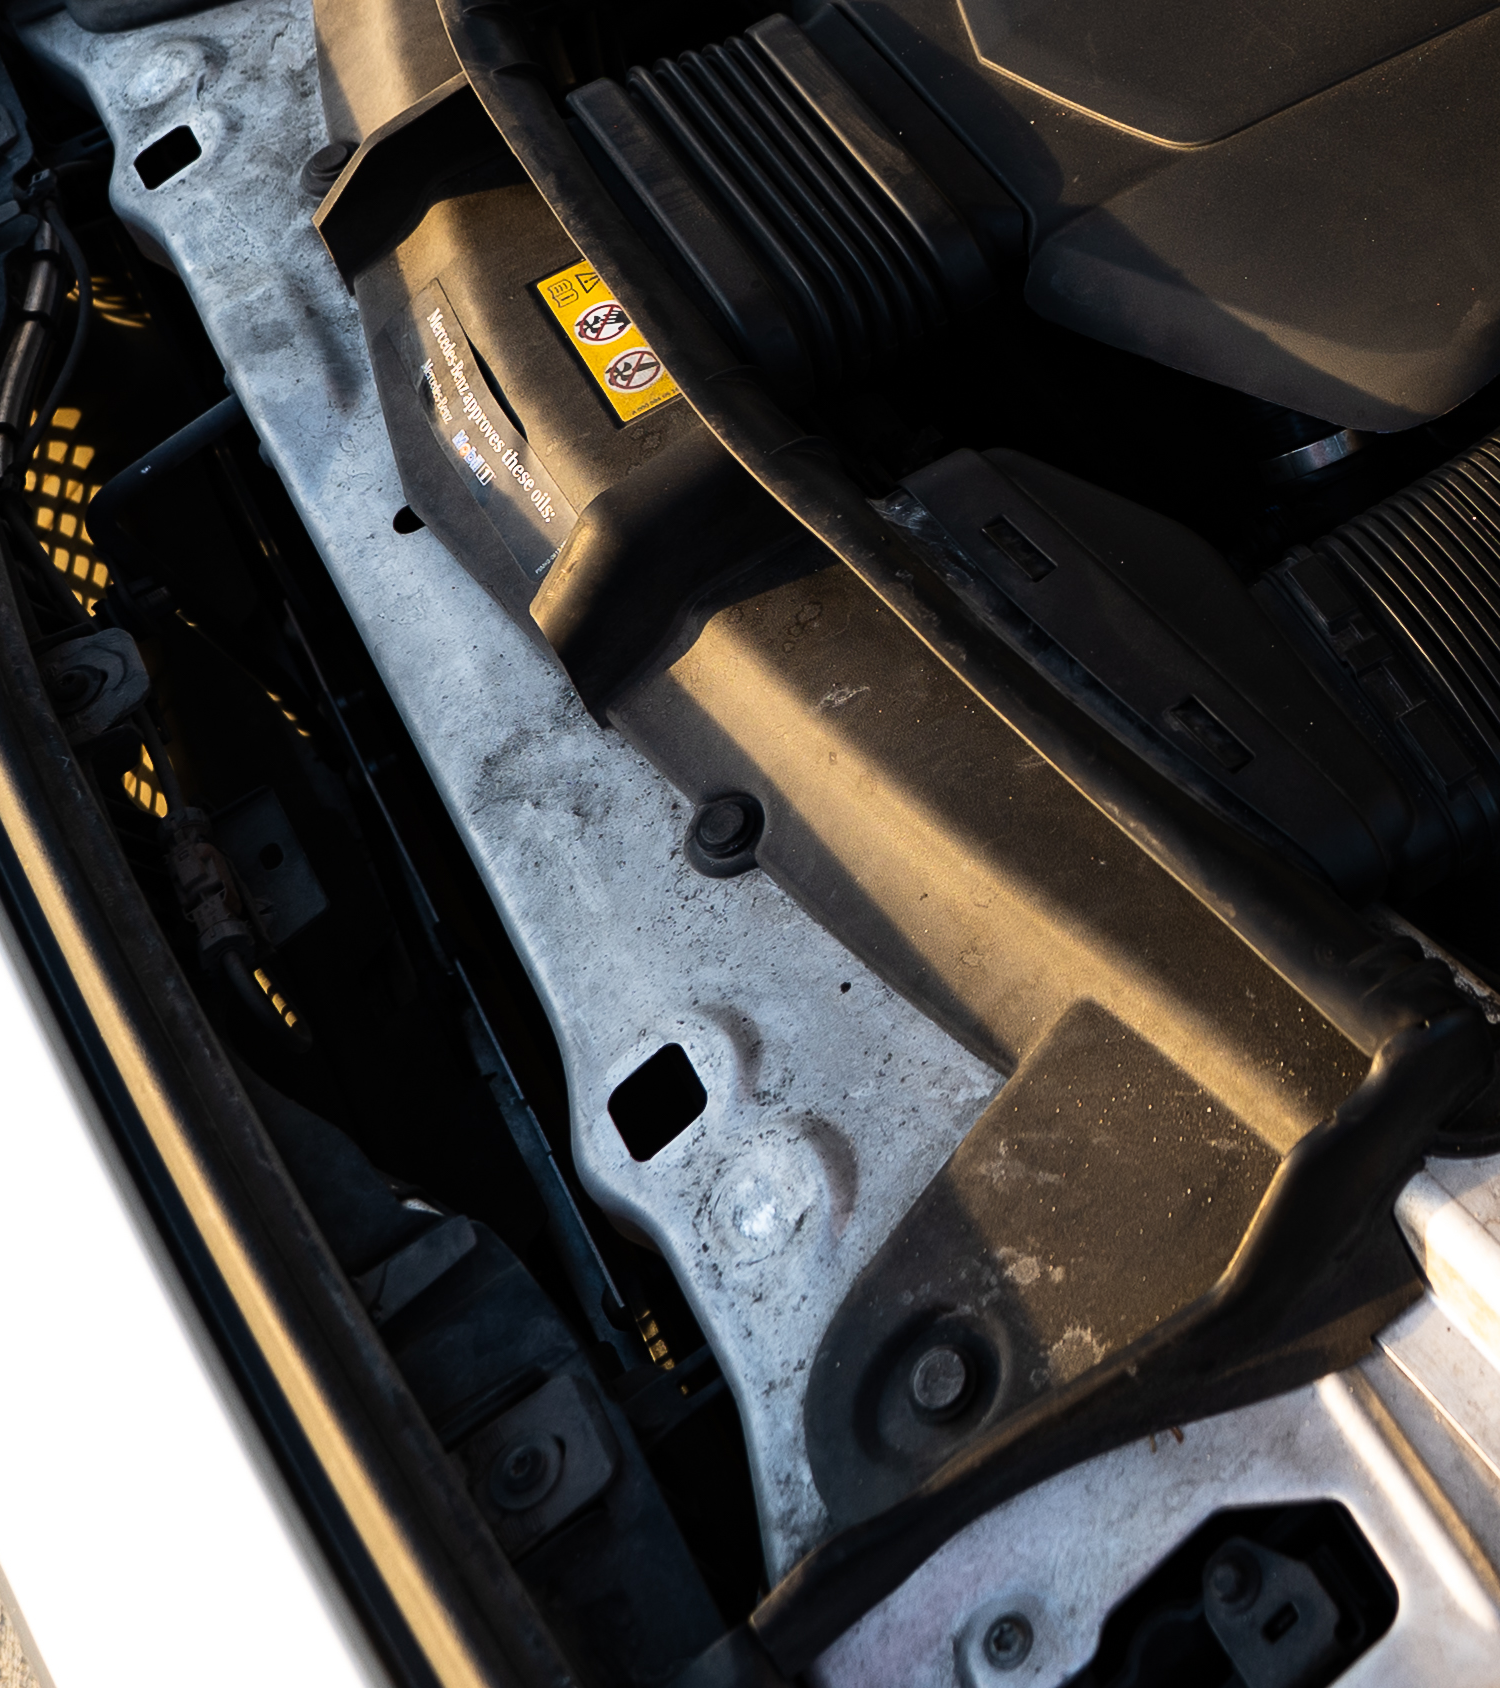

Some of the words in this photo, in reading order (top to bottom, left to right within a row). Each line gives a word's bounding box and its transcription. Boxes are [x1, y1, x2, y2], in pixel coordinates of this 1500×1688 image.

[420, 358, 454, 425] Mercedes-Benz
[426, 307, 471, 397] Mercedes-Benz
[462, 391, 507, 454] approves
[501, 448, 536, 492] these
[530, 489, 556, 523] oils:
[452, 428, 486, 473] Mobil
